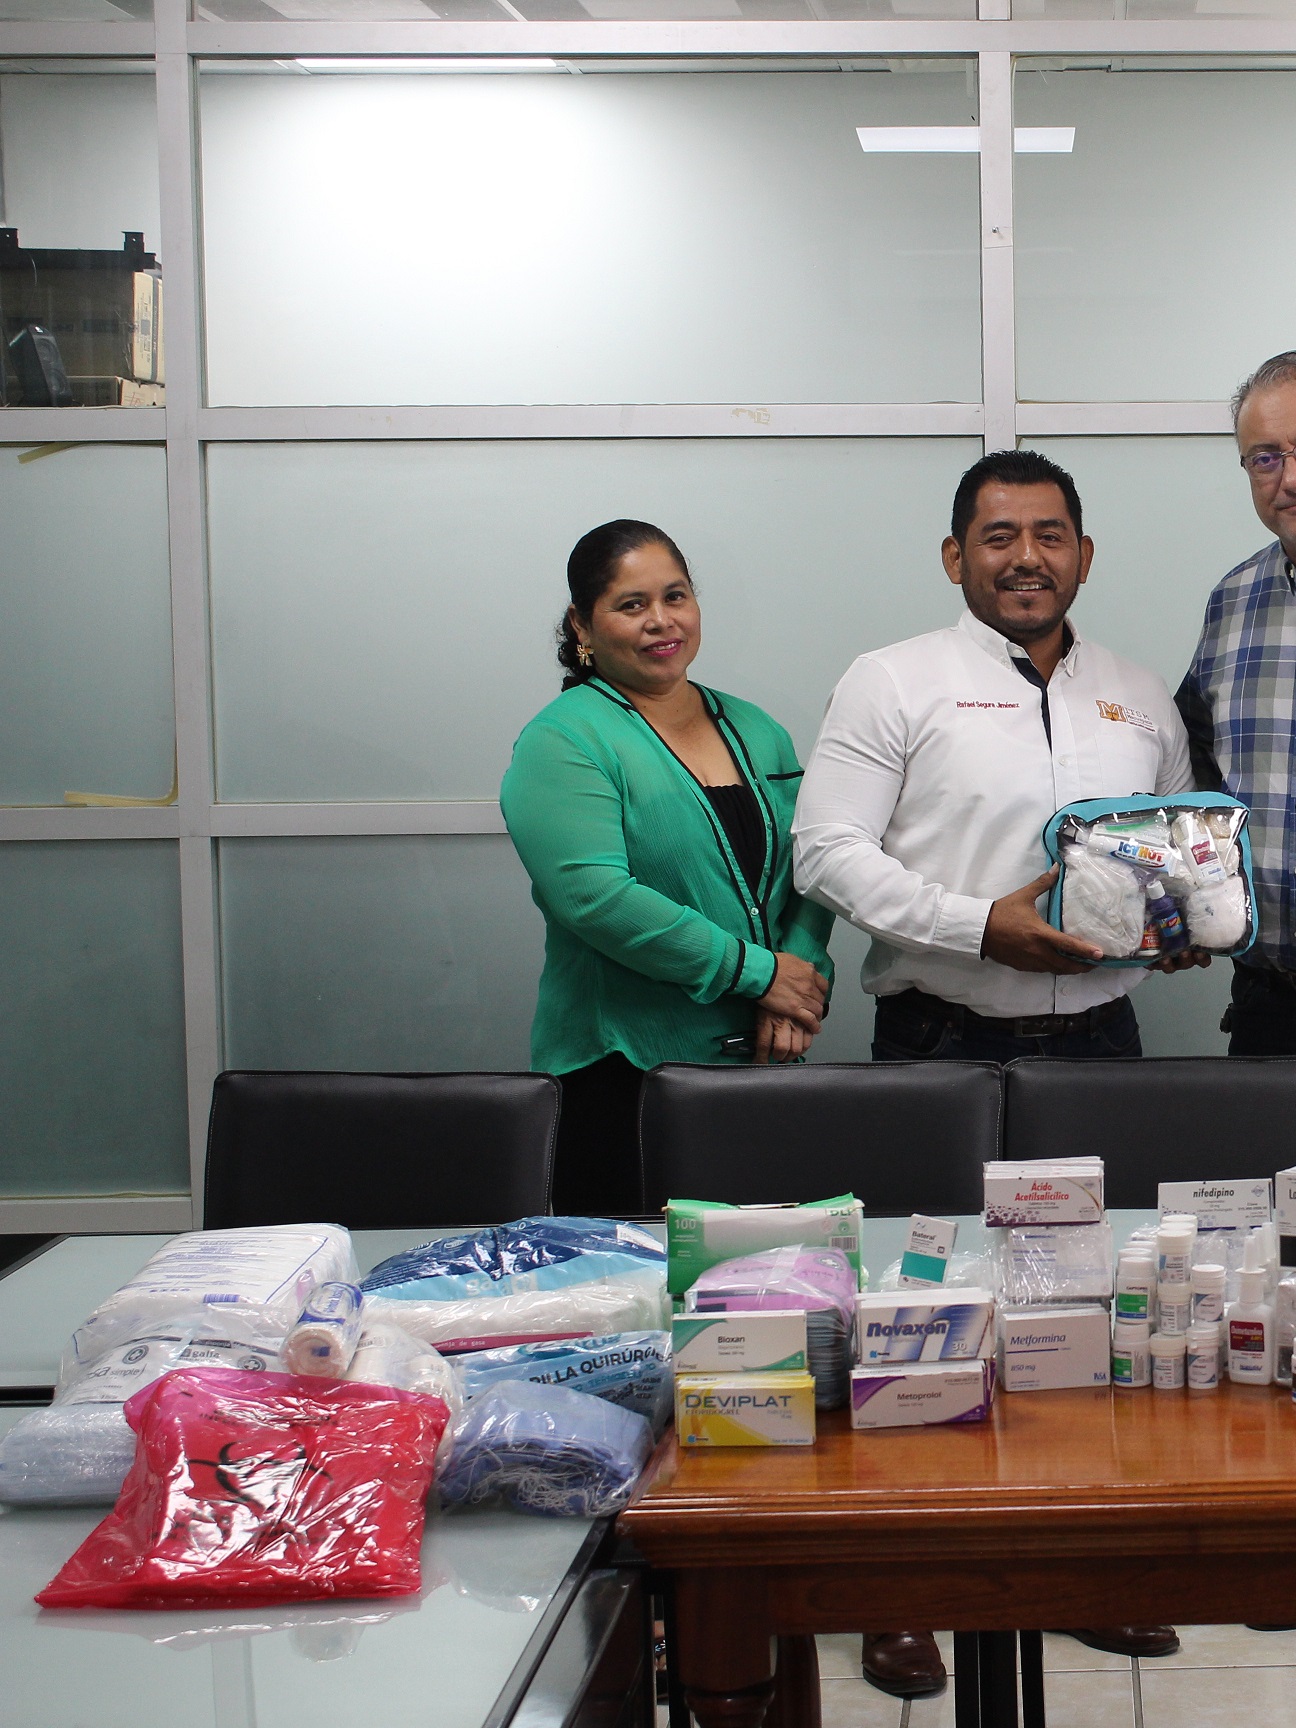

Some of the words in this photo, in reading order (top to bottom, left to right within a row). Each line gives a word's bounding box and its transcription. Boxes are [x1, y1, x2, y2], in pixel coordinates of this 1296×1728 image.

[976, 701, 995, 709] Segura
[1031, 1180, 1053, 1191] Ácido
[1015, 1192, 1070, 1201] Acetilsalicílico
[1193, 1187, 1235, 1199] nifedipino
[674, 1218, 697, 1230] 100
[1010, 1333, 1067, 1347] Metformina
[952, 1341, 967, 1351] 30
[1025, 1364, 1036, 1372] mg
[897, 1391, 942, 1401] Metoprolol
[685, 1394, 792, 1409] DEVIPLAT
